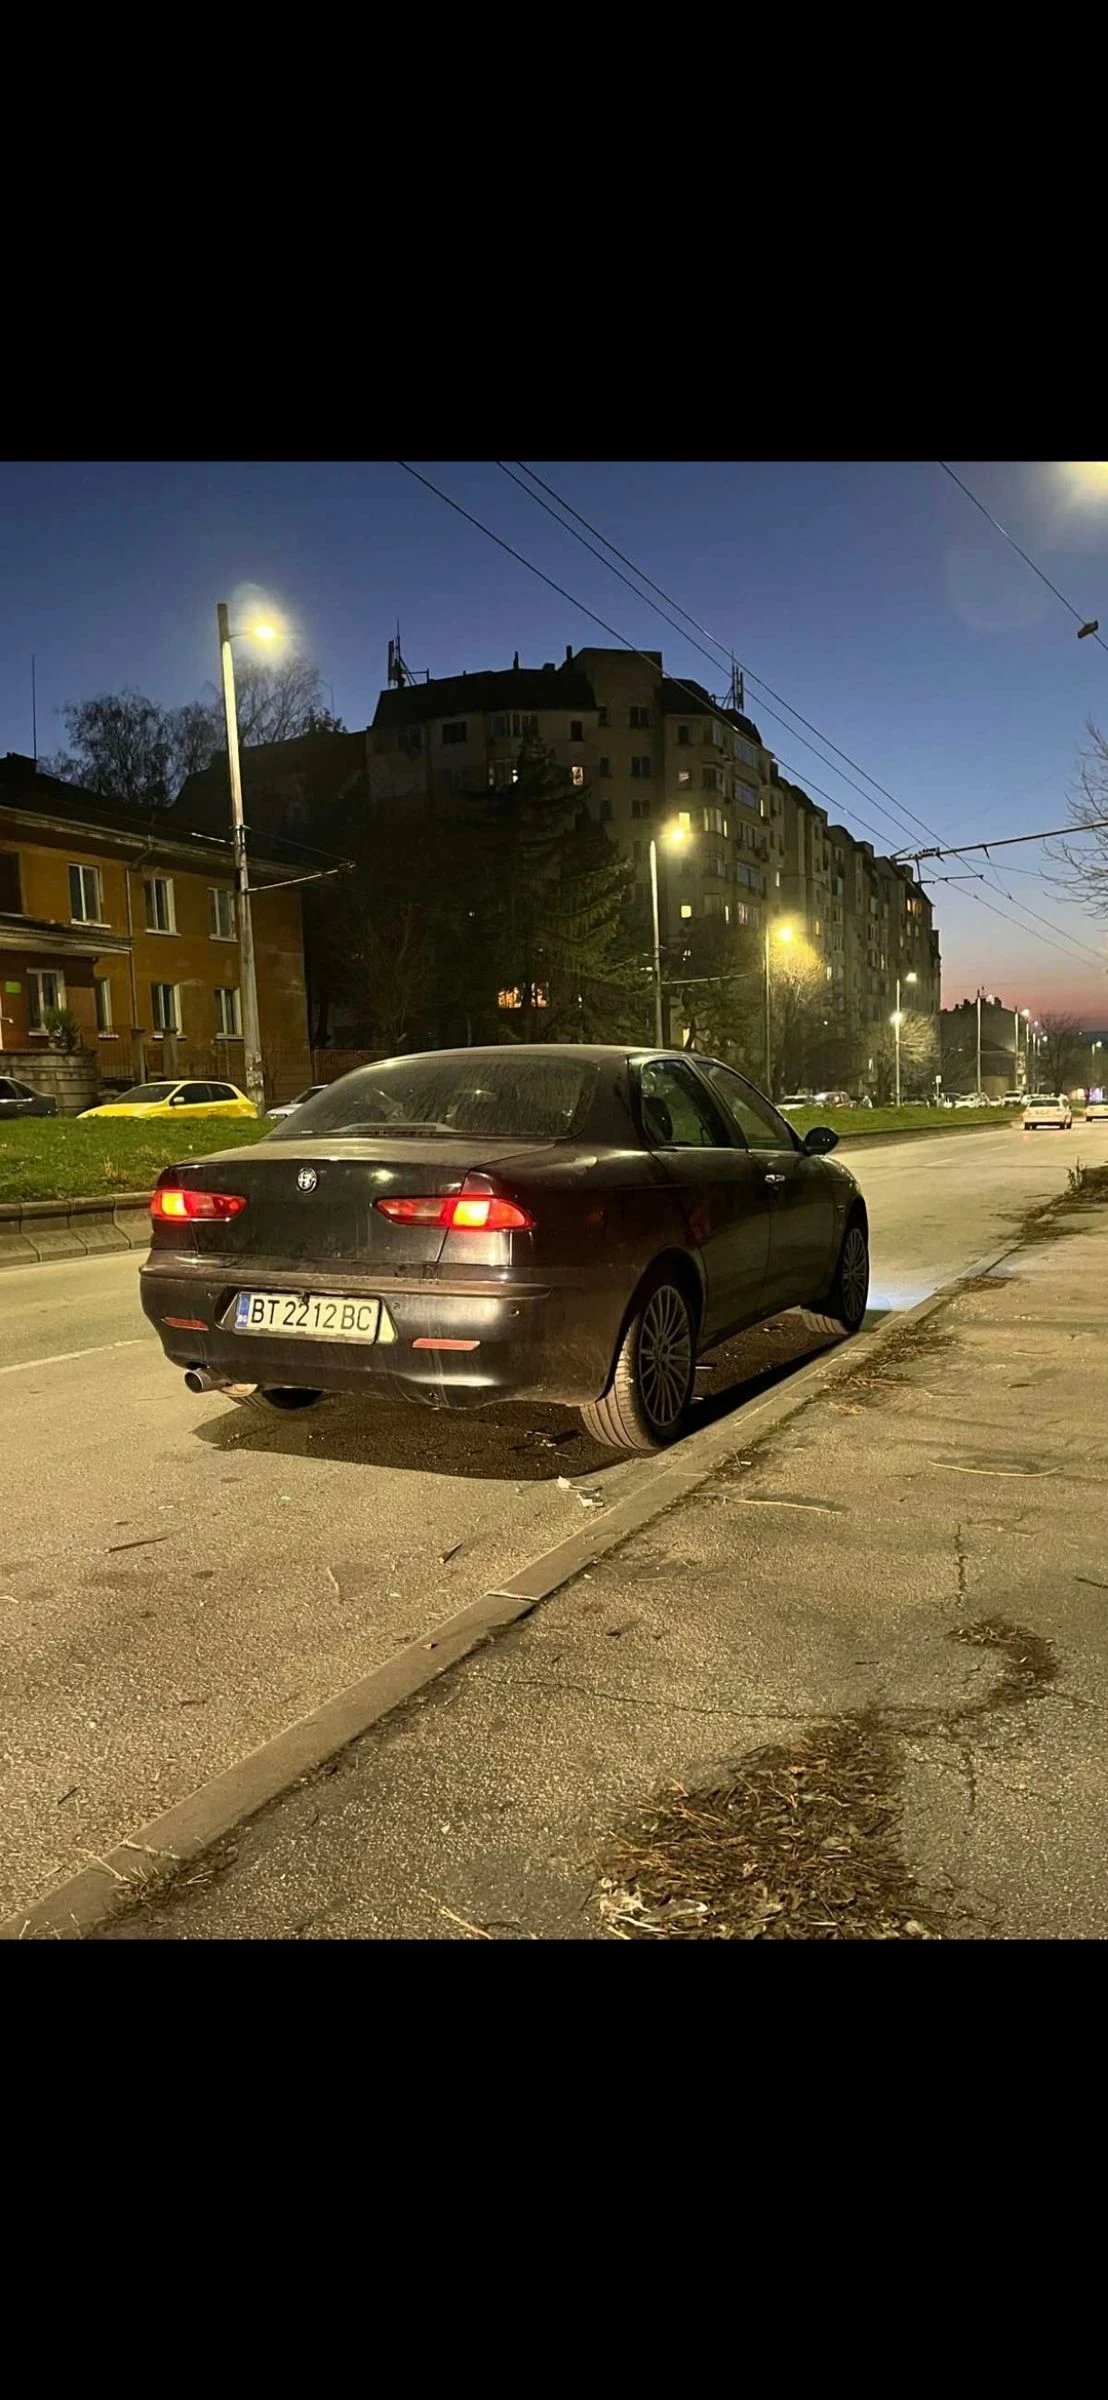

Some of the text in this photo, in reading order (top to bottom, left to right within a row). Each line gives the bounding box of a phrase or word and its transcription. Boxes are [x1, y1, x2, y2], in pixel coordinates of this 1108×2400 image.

[251, 1298, 372, 1331] BT 2212 BC
